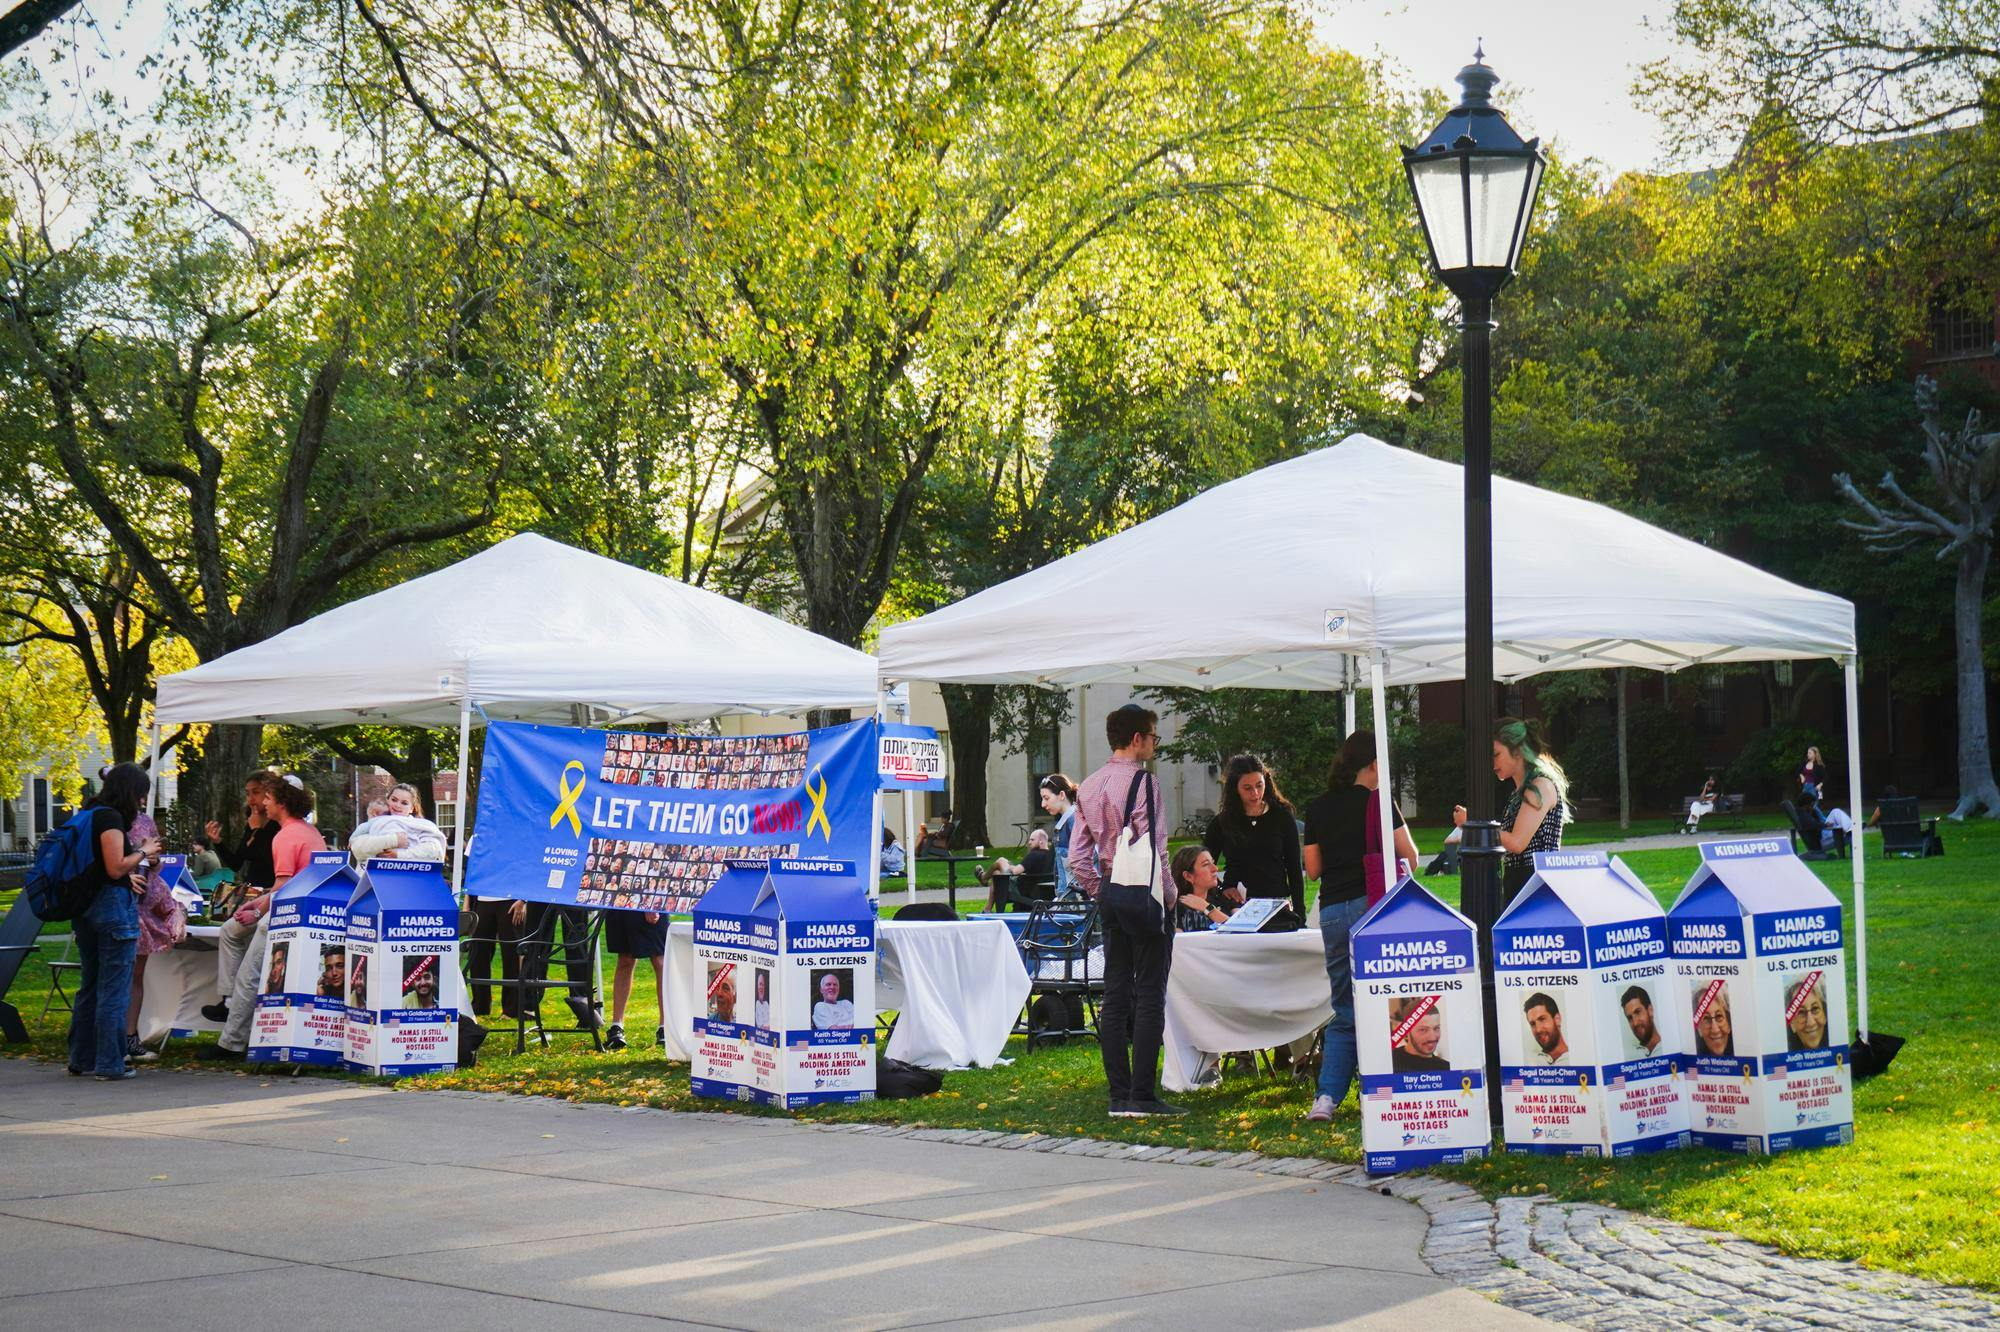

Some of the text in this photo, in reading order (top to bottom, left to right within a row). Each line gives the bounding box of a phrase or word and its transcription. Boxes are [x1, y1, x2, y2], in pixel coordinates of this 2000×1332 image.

[592, 796, 803, 835] LET THEM GO NOW!
[1714, 842, 1780, 856] KIDNAPPED
[314, 856, 343, 864] KIDNAPPED
[781, 861, 844, 871] KIDNAPPED
[1545, 855, 1599, 866] KIDNAPPED
[376, 862, 432, 872] KIDNAPPED
[276, 904, 296, 915] HAMAS
[321, 905, 346, 917] HAM
[270, 914, 300, 926] KIDNAPPED
[308, 915, 346, 927] KIDNA
[352, 915, 371, 927] HAMAS
[400, 916, 444, 926] HAMAS
[705, 919, 741, 932] HAMAS
[1774, 915, 1826, 933] HAMAS
[347, 926, 376, 939] KIDNAPPED
[388, 927, 455, 938] KIDNAPPED
[754, 924, 772, 937] HAMAS
[807, 924, 856, 935] HAMAS
[1606, 926, 1651, 944] HAMAS
[1682, 924, 1726, 938] HAMAS
[310, 932, 326, 940] U.S.
[697, 930, 750, 945] KIDNAPPED
[1512, 934, 1565, 949] HAMAS
[1762, 930, 1840, 950] KIDNAPPED
[411, 944, 452, 952] CITIZENS
[750, 935, 777, 950] KIDNAPPED
[793, 937, 870, 949] KIDNAPPED
[1381, 940, 1447, 957] HAMAS
[1673, 940, 1740, 954] KIDNAPPED
[700, 949, 748, 961] U.S. CITIZENS
[1595, 940, 1664, 962] KIDNAPPED
[797, 956, 866, 966] U.S. CITIZENS
[1500, 950, 1580, 965] KIDNAPPED
[1768, 955, 1838, 971] U.S. CITIZENS
[1364, 955, 1467, 974] KIDNAPPED
[1678, 966, 1739, 975] U.S. CITIZENS
[404, 956, 433, 986] EXECUTED
[1602, 964, 1664, 983] U.S. CITIZENS
[708, 964, 731, 995] MURDERED
[1504, 976, 1578, 987] U.S. CITIZENS
[1370, 980, 1463, 995] U.S. CITIZENS
[1694, 981, 1720, 1024] MURDERED
[1786, 973, 1817, 1020] MURDERED
[304, 1021, 328, 1029] HOLDING
[1392, 996, 1433, 1042] MURDERED
[727, 1044, 738, 1052] STILL
[700, 1049, 744, 1061] HOLDING AMERICAN
[709, 1059, 732, 1068] HOSTAGES
[826, 1079, 840, 1087] IAC
[1403, 1074, 1442, 1083] Itay Chen
[1787, 1076, 1835, 1089] HAMAS IS STILL
[1626, 1084, 1671, 1099] HAMAS IS STILL
[1698, 1084, 1742, 1094] HAMAS IS STILL
[1779, 1086, 1842, 1101] HOLDING AMERICAN
[1392, 1099, 1458, 1110] HAMAS IS STILL
[1523, 1095, 1576, 1103] HAMAS IS STILL
[1620, 1093, 1679, 1112] HOLDING AMERICAN
[1692, 1094, 1750, 1104] HOLDING AMERICAN
[1797, 1098, 1829, 1110] HOSTAGES
[1381, 1109, 1469, 1122] HOLDING AMERICAN
[1515, 1105, 1586, 1114] HOLDING AMERICAN
[1637, 1106, 1667, 1119] HOSTAGES
[1706, 1105, 1736, 1114] HOSTAGES
[1403, 1120, 1448, 1131] HOSTAGES
[1533, 1116, 1569, 1124] HOSTAGES
[1417, 1134, 1436, 1144] IAC
[1545, 1129, 1560, 1138] IAC
